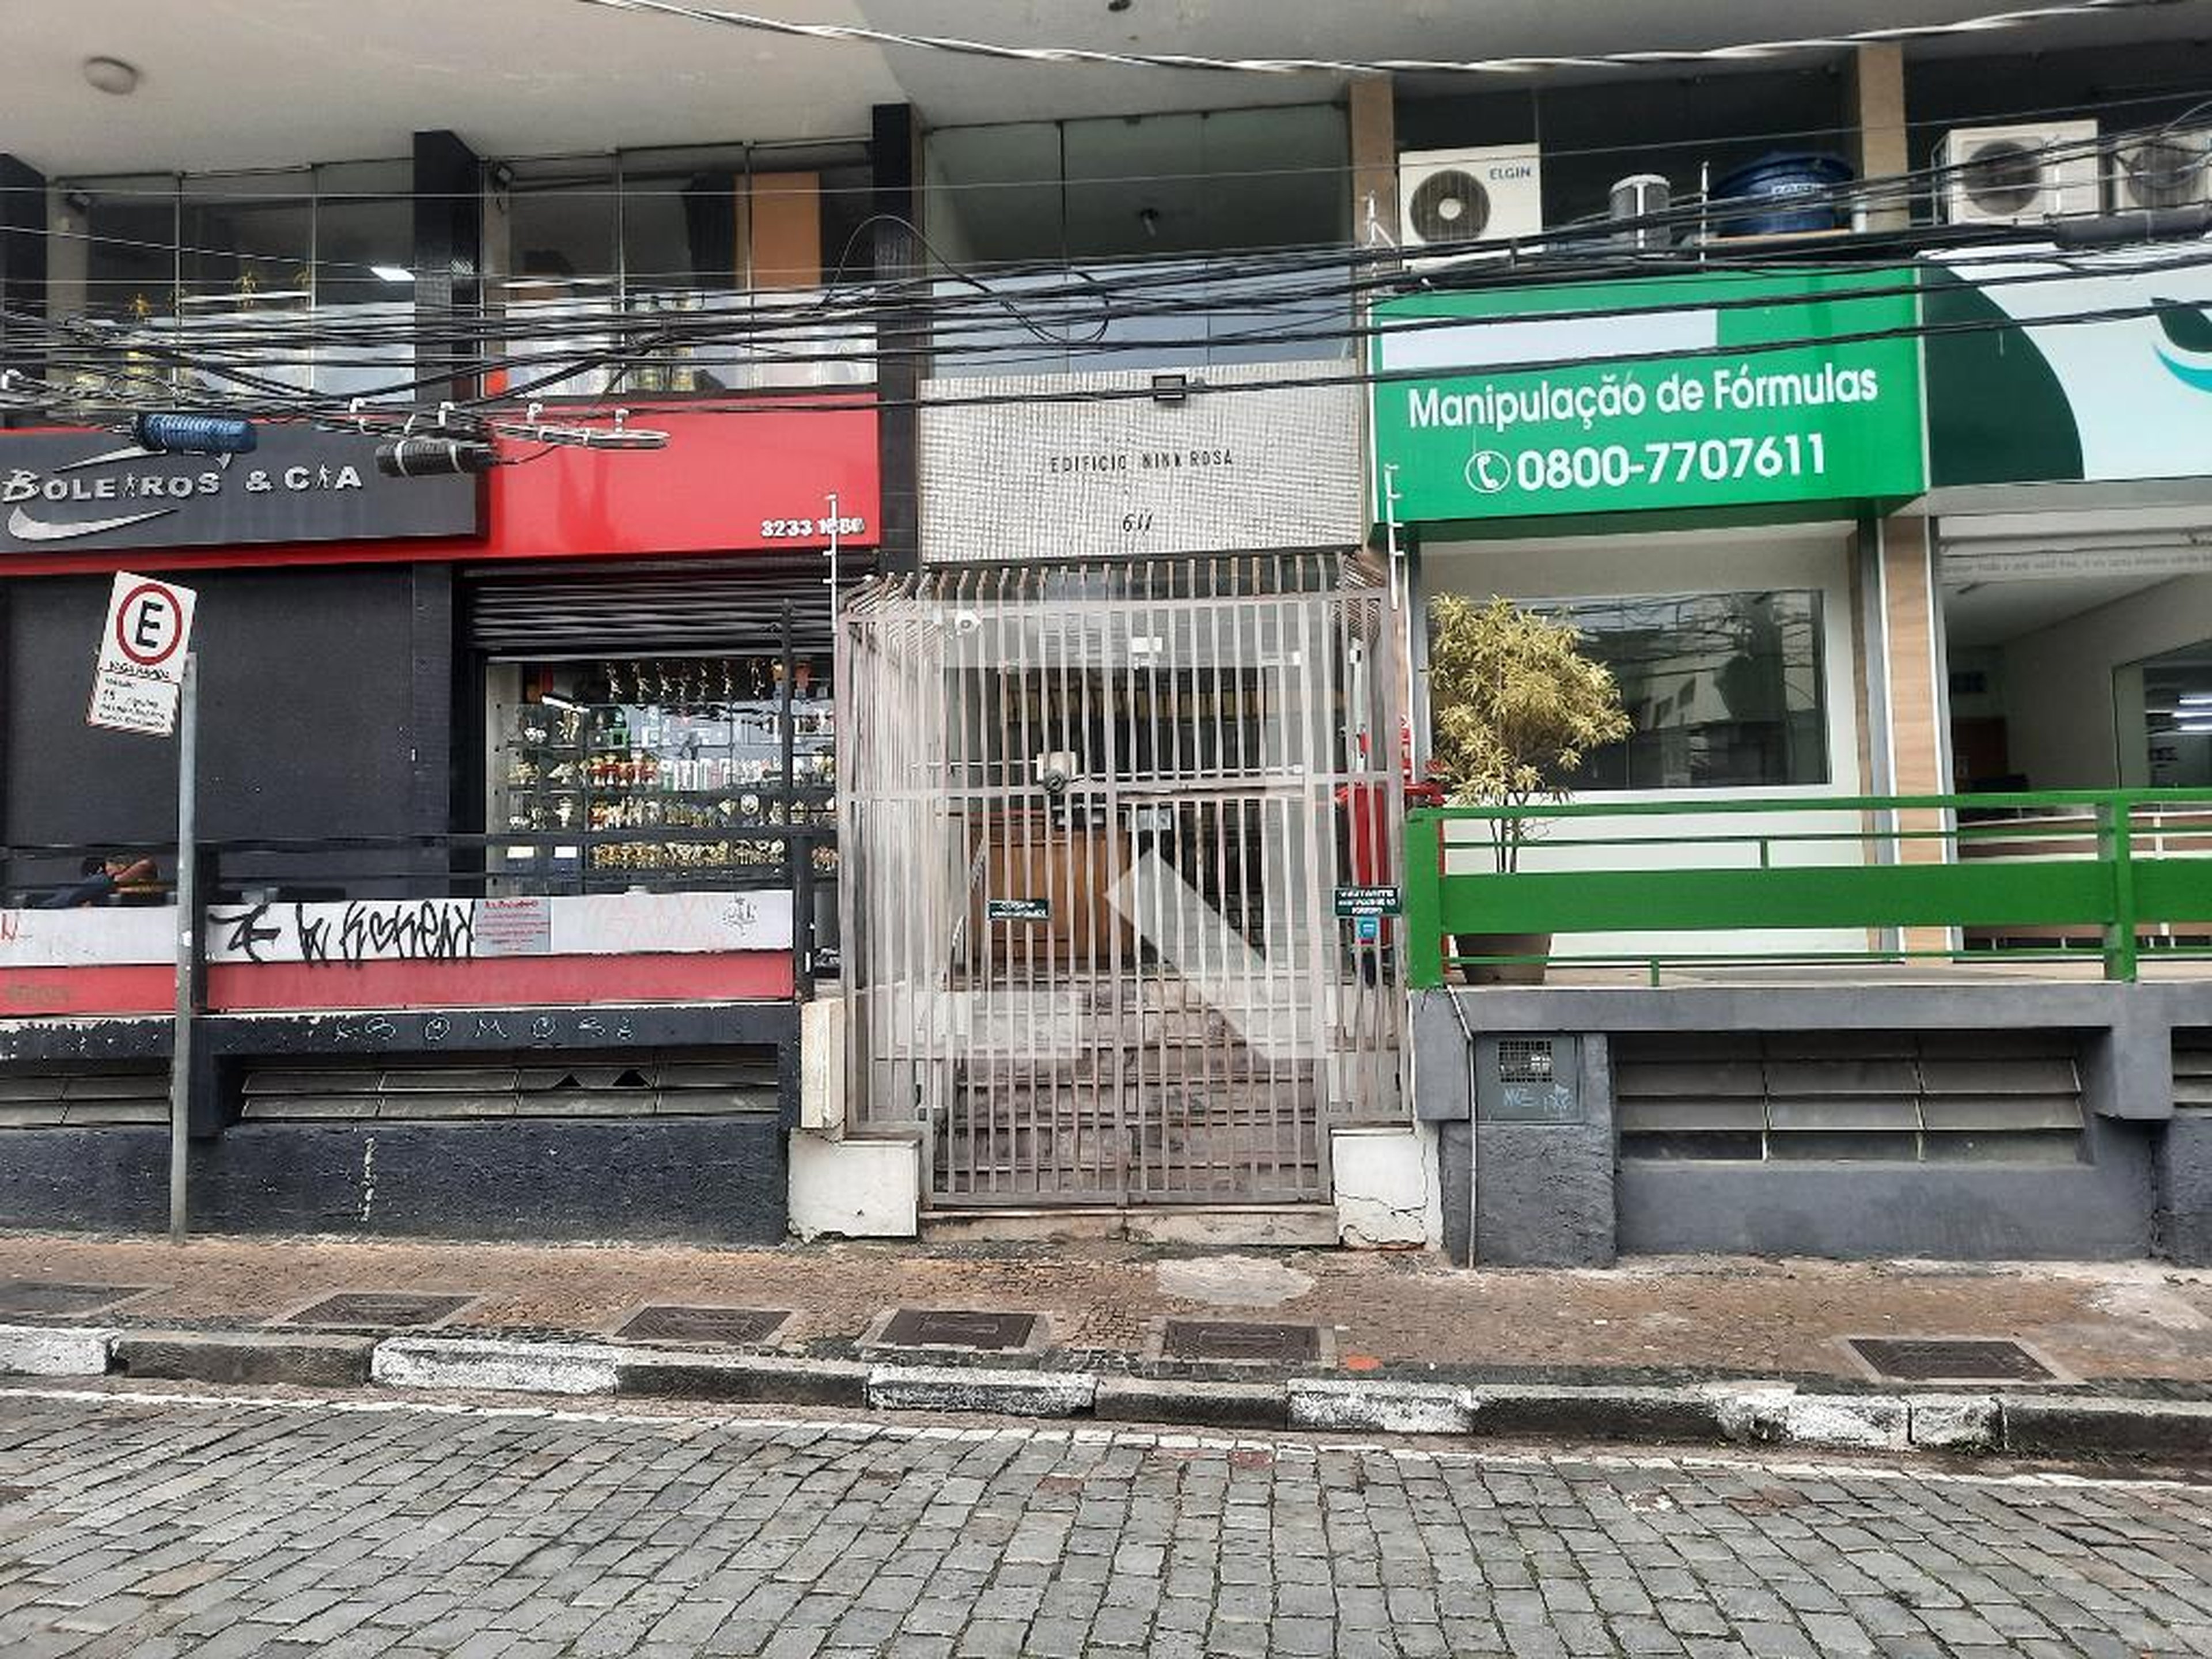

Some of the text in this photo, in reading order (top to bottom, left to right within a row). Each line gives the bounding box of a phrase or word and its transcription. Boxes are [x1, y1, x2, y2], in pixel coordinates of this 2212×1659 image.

[1489, 166, 1531, 180] ELGIN
[1408, 362, 1878, 433] Manipulação de Fórmulas
[1051, 454, 1127, 473] EDIFICIO
[1190, 448, 1233, 467] ROSA
[1517, 433, 1825, 491] 0800-7707611
[245, 469, 273, 491] &
[761, 519, 813, 537] 3233
[1122, 512, 1153, 532] 611
[135, 600, 164, 649] E
